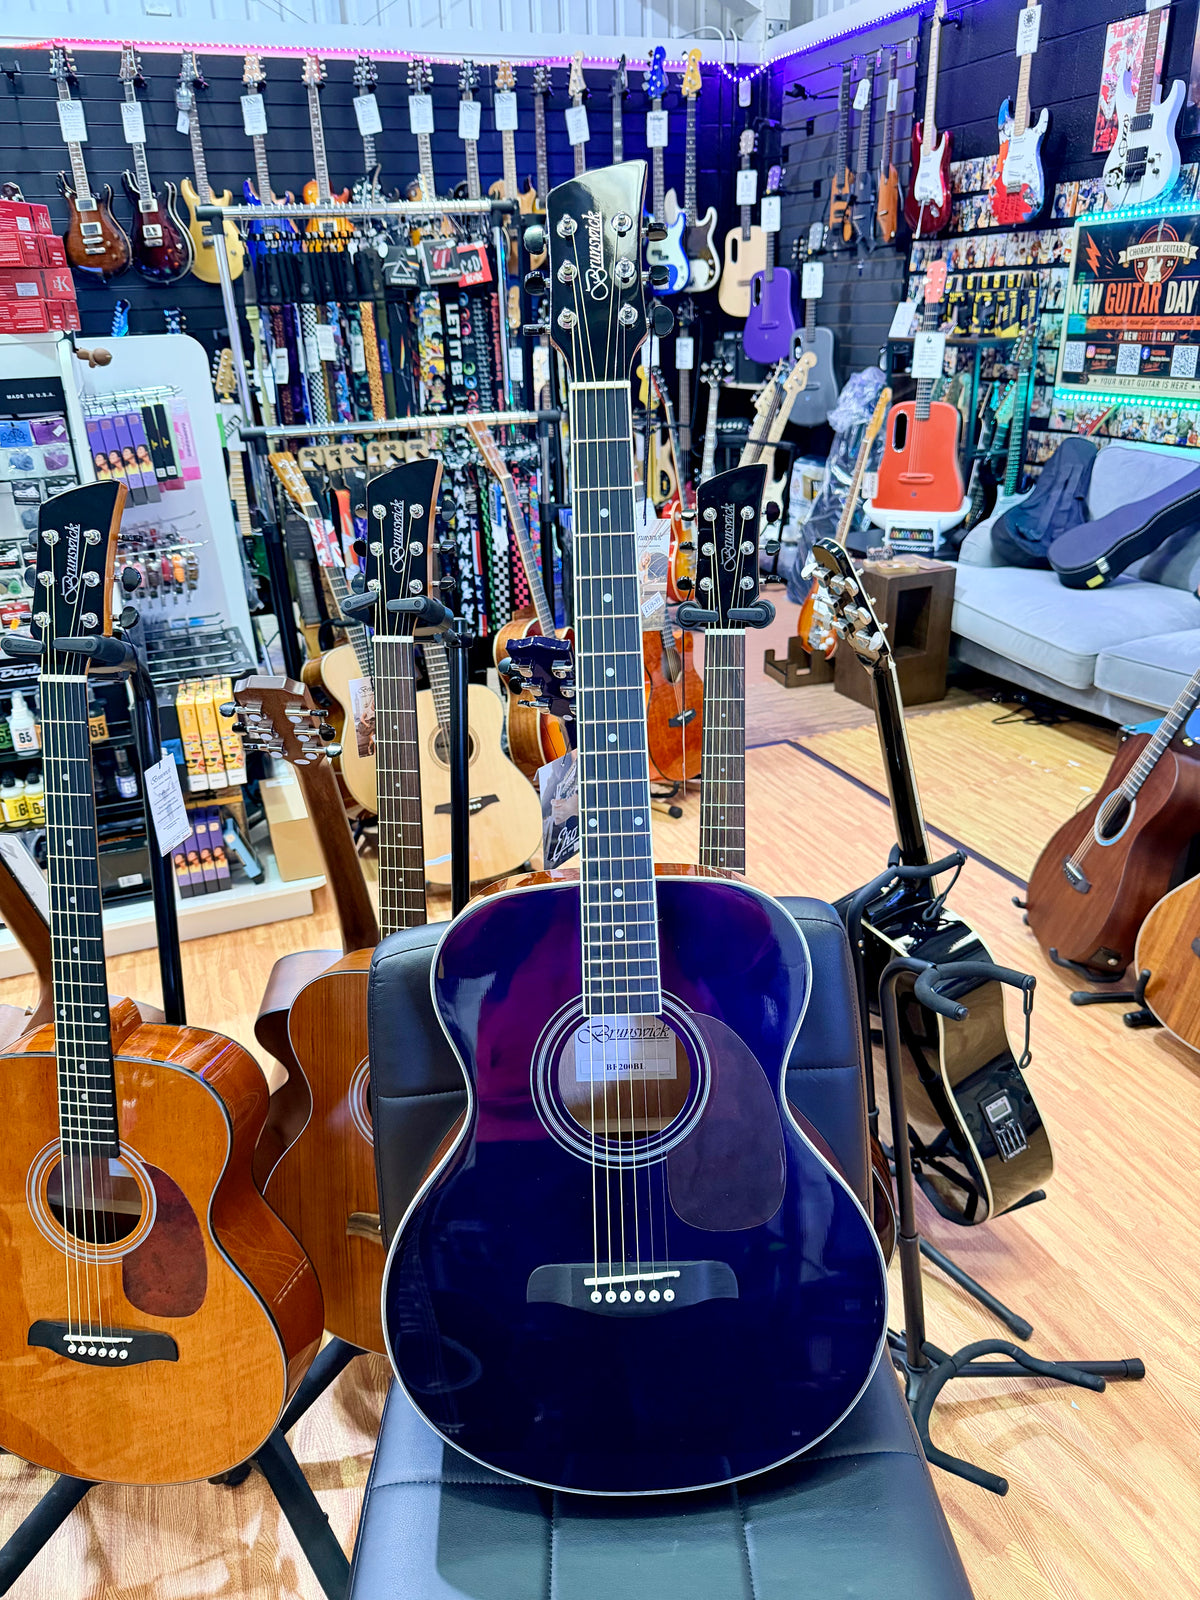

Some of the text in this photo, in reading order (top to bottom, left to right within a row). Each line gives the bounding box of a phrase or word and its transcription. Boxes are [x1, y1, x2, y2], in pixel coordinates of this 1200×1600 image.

[581, 209, 609, 301] Brunswick
[1129, 244, 1187, 257] CHORDPLAY GUITARS
[1068, 279, 1200, 315] NEW GUITAR DAY
[445, 303, 461, 339] LET
[1118, 331, 1176, 342] #NEWGUITARDAY
[448, 340, 463, 360] IT
[450, 361, 464, 386] BE
[1099, 376, 1189, 390] YOUR NEXT GUITAR IS HERE
[389, 499, 405, 573] Brunswick
[720, 502, 737, 572] Brunswick
[60, 522, 81, 605] Brunswick
[0, 663, 42, 679] Dunl
[18, 731, 33, 744] 65
[90, 722, 105, 738] 65
[123, 781, 138, 794] 65
[550, 825, 578, 862] Eko
[577, 1022, 671, 1044] Brunswick
